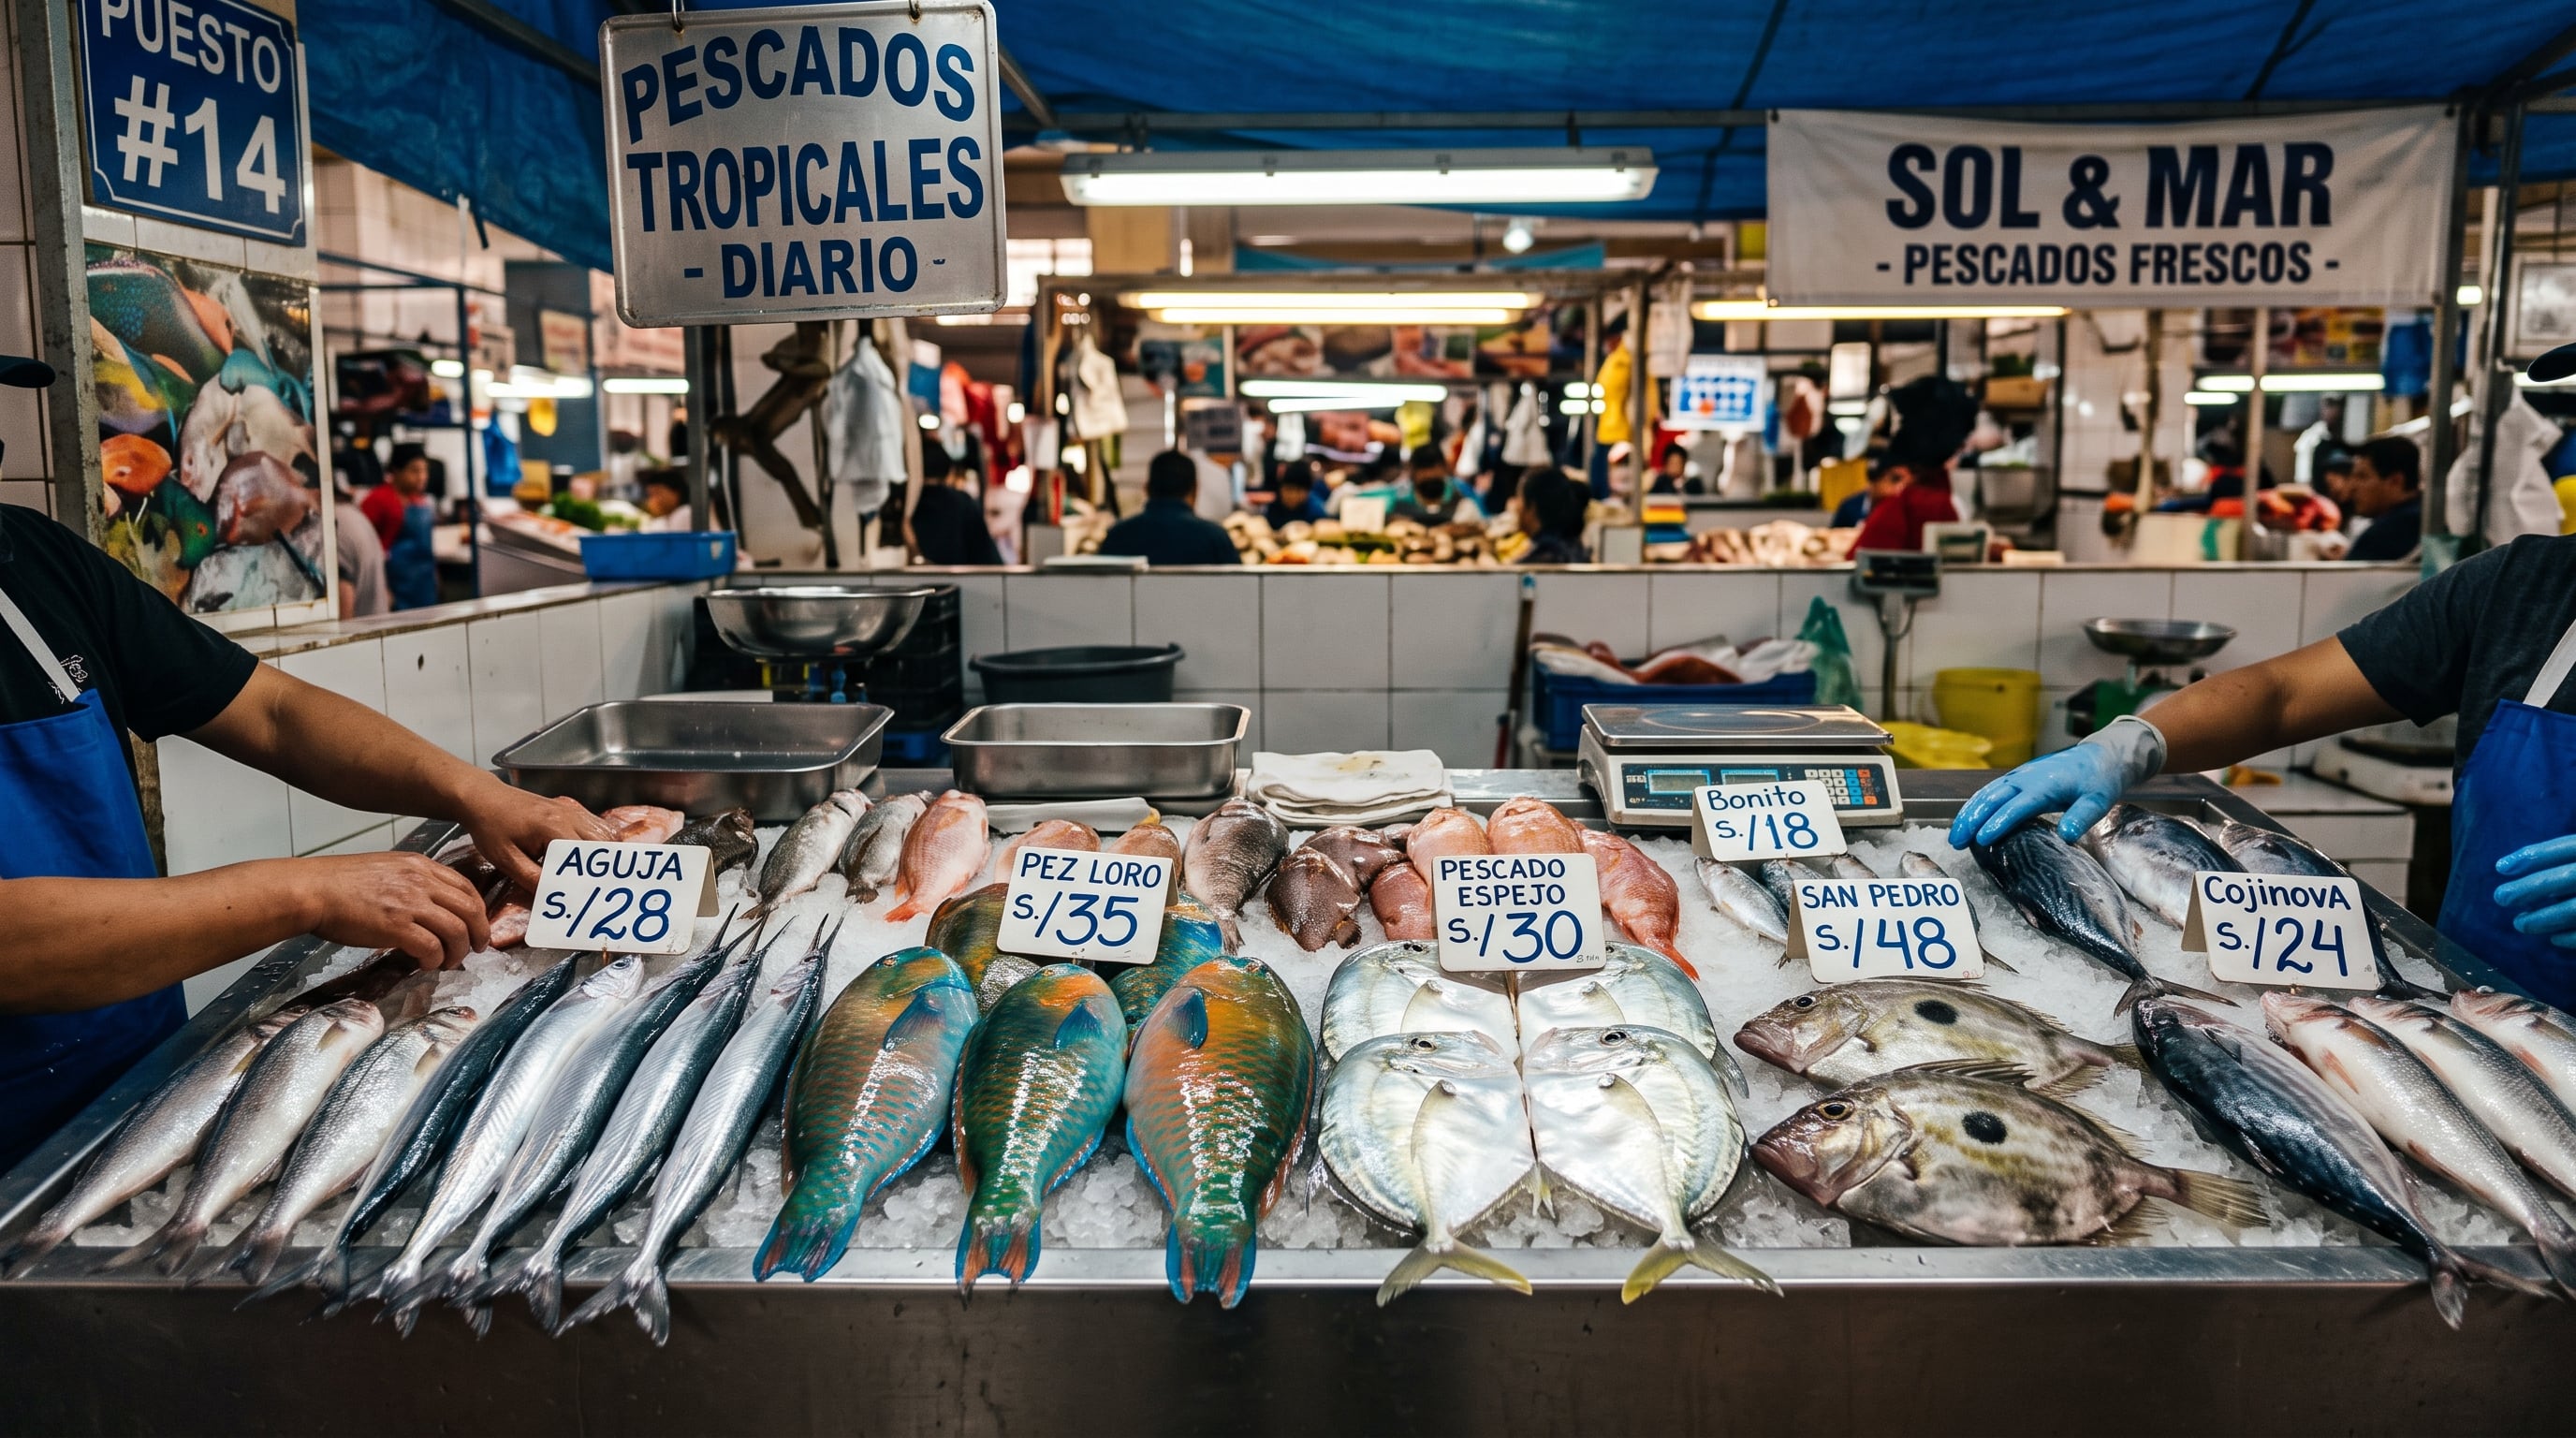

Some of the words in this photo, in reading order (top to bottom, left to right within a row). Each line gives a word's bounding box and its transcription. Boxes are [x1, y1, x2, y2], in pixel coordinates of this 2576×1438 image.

[100, 0, 281, 94] PUESTO
[622, 25, 975, 144] PESCADOS
[114, 75, 286, 214] #14
[626, 136, 984, 232] TROPICALES
[1885, 142, 2040, 229] SOL
[2062, 155, 2121, 229] &
[2144, 141, 2334, 228] MAR
[721, 236, 918, 299] DIARIO
[1904, 242, 2116, 285] PESCADOS
[2129, 241, 2312, 285] FRESCOS
[1706, 785, 1806, 811] Bonito
[1715, 812, 1819, 851] S./18
[556, 847, 683, 881] AGUJA
[1020, 852, 1078, 882] PEZ
[1089, 859, 1162, 888] LORO
[1441, 858, 1566, 881] PESCADO
[542, 887, 672, 943] S./28
[1012, 891, 1139, 946] S./35
[1457, 884, 1566, 907] ESPEJO
[1802, 885, 1859, 909] SAN
[1868, 884, 1960, 908] PEDRO
[1448, 910, 1583, 963] S./30
[1815, 917, 1956, 969] S./48
[2217, 917, 2349, 976] S./24
